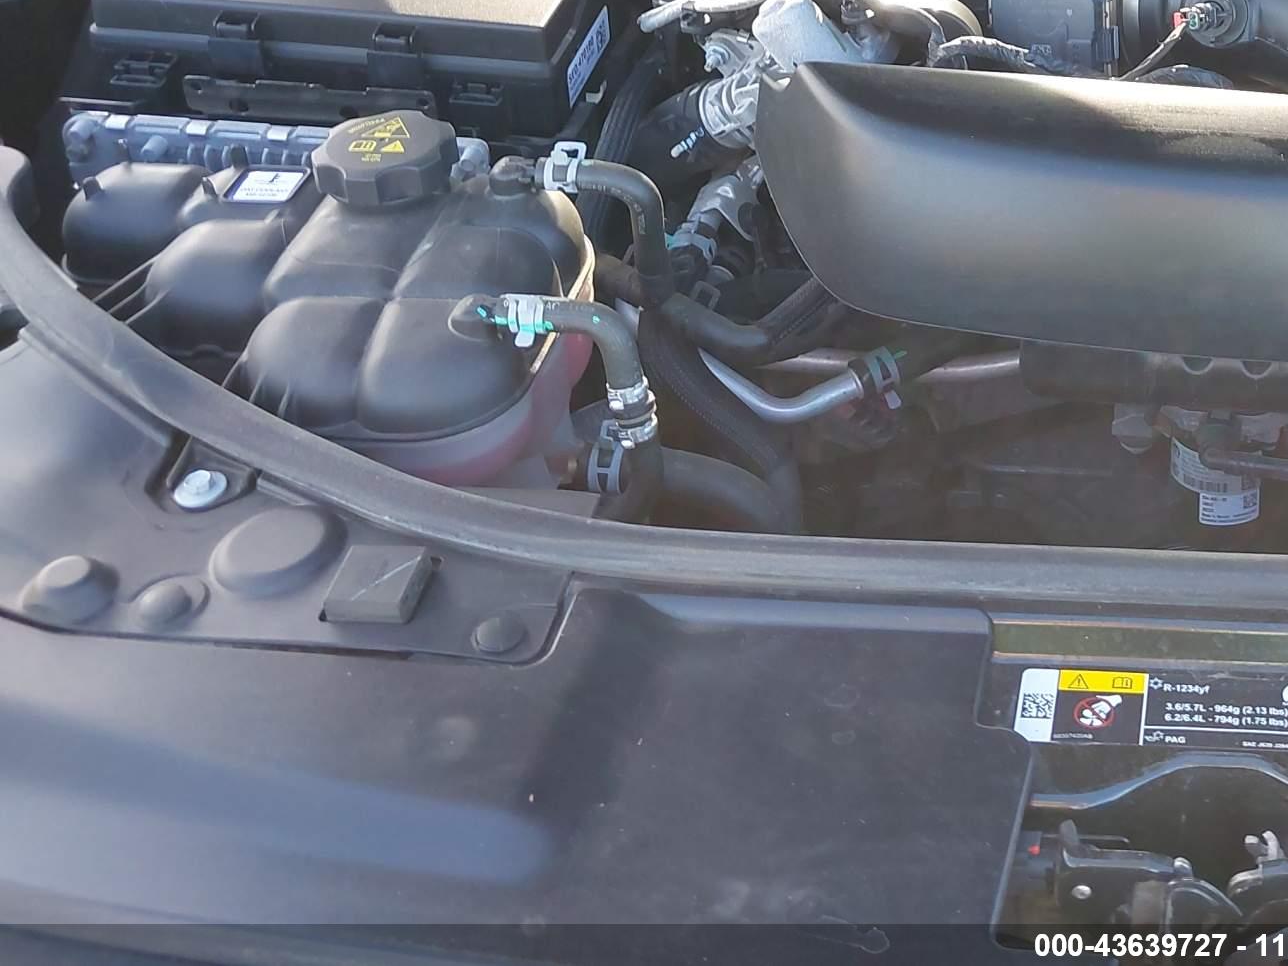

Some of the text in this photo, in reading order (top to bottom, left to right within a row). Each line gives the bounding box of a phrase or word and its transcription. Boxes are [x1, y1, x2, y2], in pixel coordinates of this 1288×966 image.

[1163, 684, 1211, 695] R-1234yf
[1165, 702, 1207, 713] 3.6/5.7L
[1214, 704, 1240, 716] 964g
[1242, 705, 1267, 716] (2.13
[1164, 713, 1207, 723] 6.2/6.4L
[1214, 715, 1240, 726] 794g
[1242, 716, 1267, 727] (1.75
[1165, 736, 1187, 744] PAG
